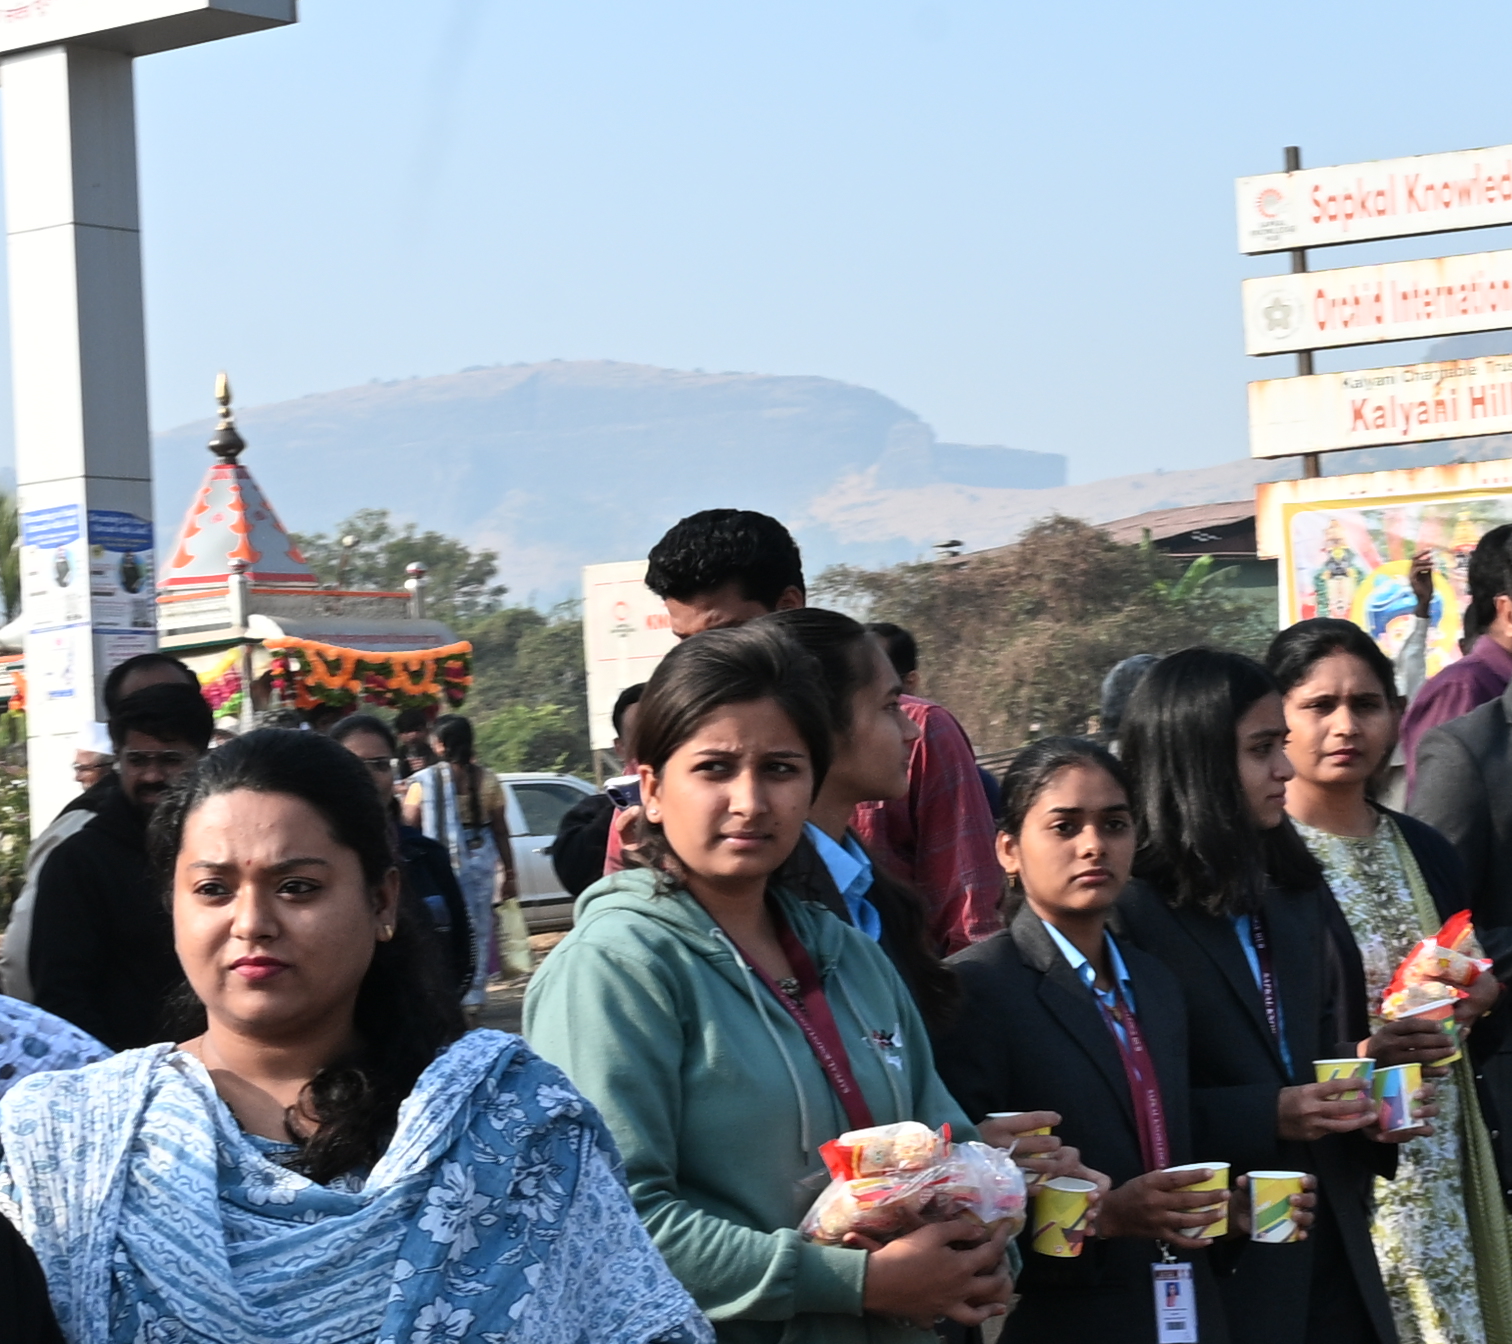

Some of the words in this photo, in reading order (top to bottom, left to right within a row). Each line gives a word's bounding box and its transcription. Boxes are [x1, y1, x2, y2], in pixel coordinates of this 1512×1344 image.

[1311, 173, 1397, 232] Sapkal
[1314, 280, 1384, 332] Orchid
[1351, 388, 1459, 436] Kalyani
